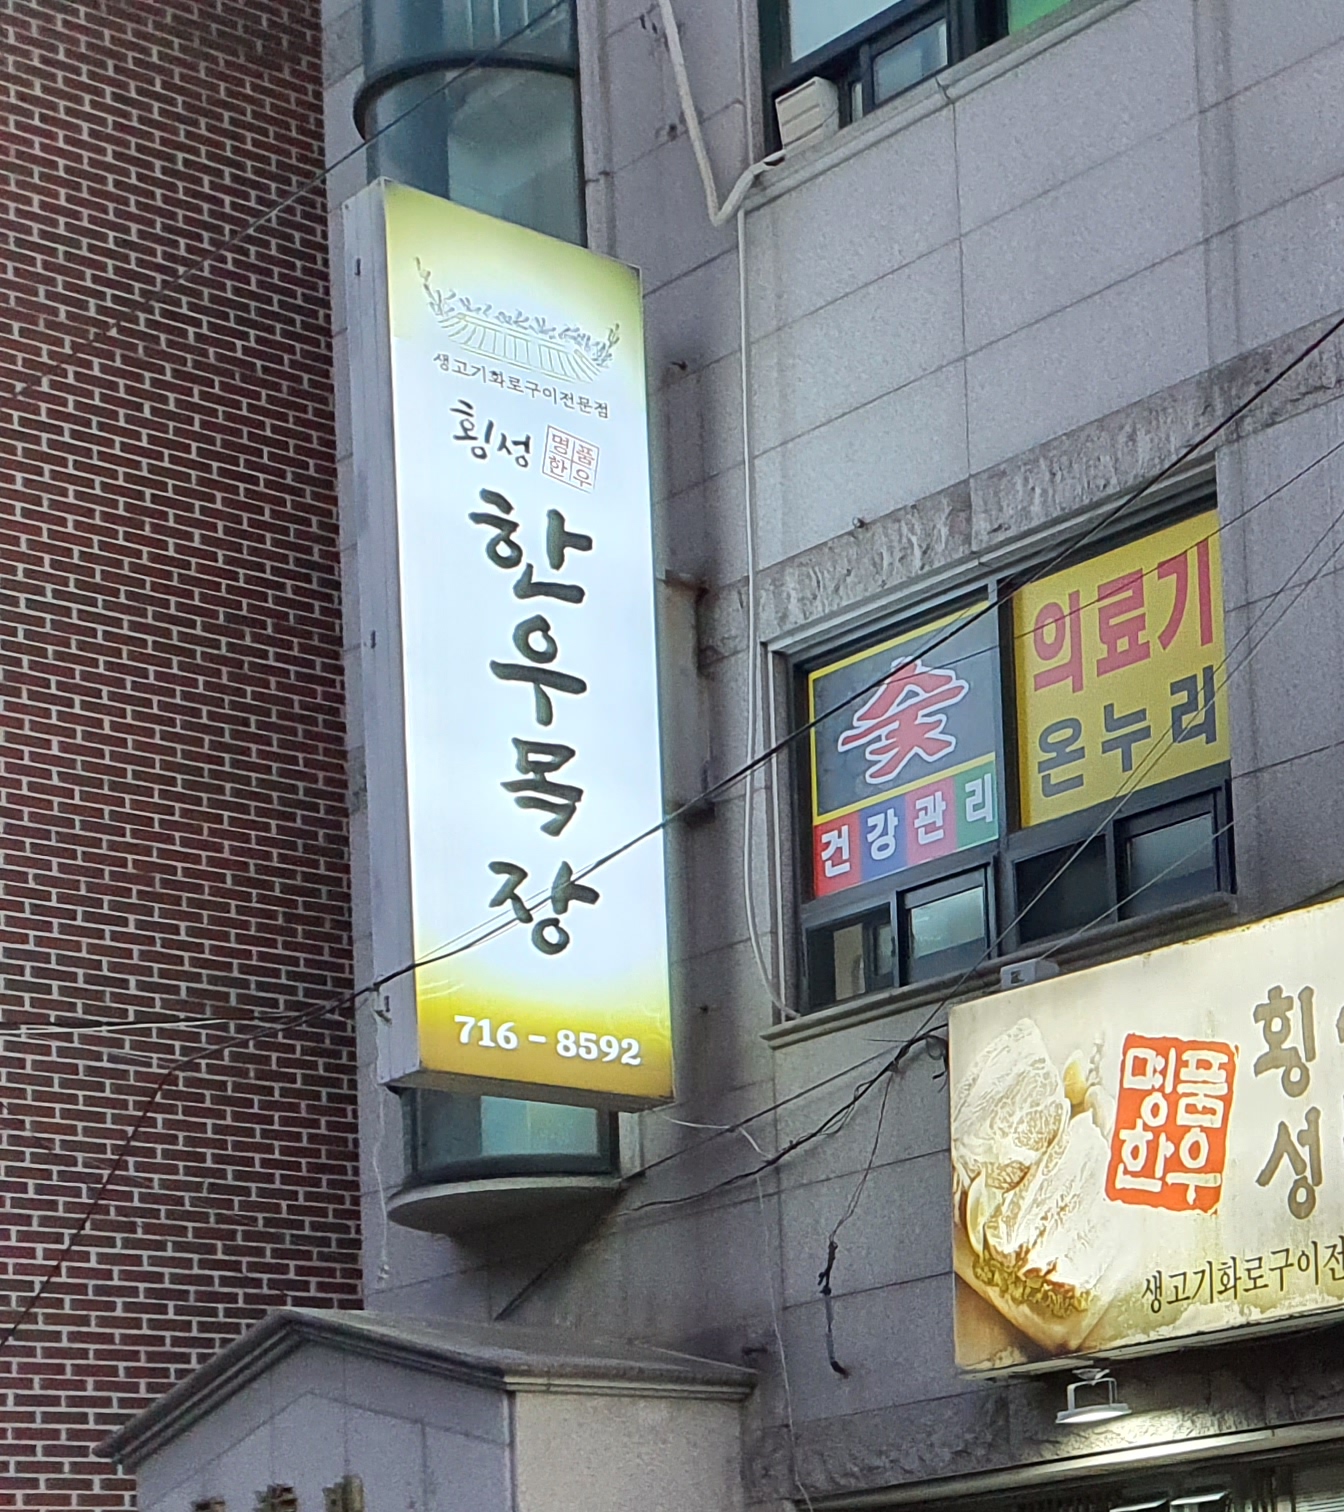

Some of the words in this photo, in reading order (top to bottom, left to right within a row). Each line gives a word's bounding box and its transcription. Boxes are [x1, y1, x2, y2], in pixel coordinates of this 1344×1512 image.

[432, 352, 609, 419] 생고기화로구이전문점
[449, 398, 532, 468] 횡성
[548, 455, 593, 488] 한우
[550, 433, 596, 466] 명품
[1032, 537, 1214, 694] 의료기
[467, 487, 601, 956] 한우목장
[1036, 664, 1217, 799] 온누리
[820, 771, 994, 879] 건강관리
[1121, 1046, 1233, 1127] 명품
[1252, 984, 1323, 1220] 횡성
[1113, 1125, 1224, 1205] 한우
